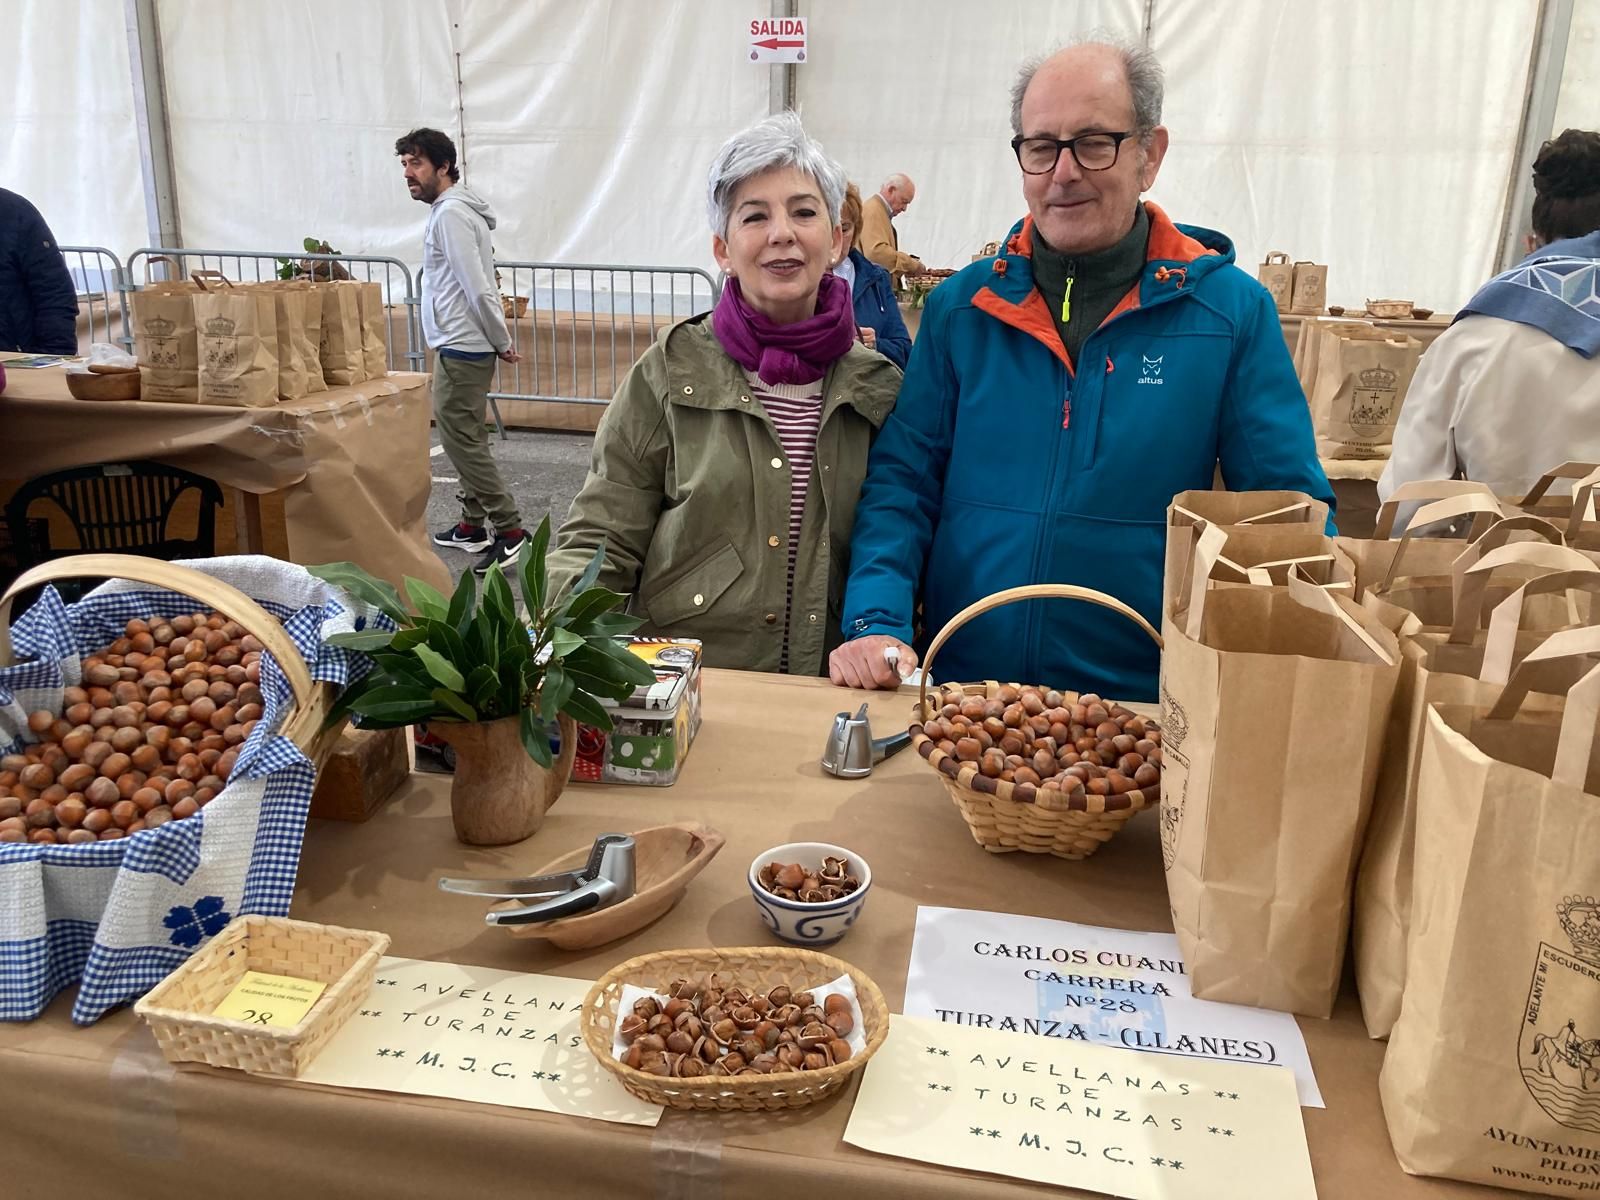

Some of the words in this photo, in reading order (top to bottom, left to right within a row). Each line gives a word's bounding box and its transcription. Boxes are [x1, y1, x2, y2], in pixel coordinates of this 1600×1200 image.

[750, 20, 804, 36] SALIDA
[1137, 376, 1164, 385] altus
[973, 941, 1089, 965] CARLOS
[1023, 969, 1175, 998] CARRERA
[1527, 974, 1546, 1026] ADELANTE
[1538, 961, 1549, 974] MI
[481, 1007, 521, 1021] DE
[1065, 993, 1137, 1014] Nº28
[401, 1011, 583, 1048] TURANZAS
[934, 1009, 1091, 1042] TURANZA
[1120, 1027, 1277, 1063] (LLANES)
[969, 1053, 1191, 1096] AVELLANAS
[1056, 1083, 1099, 1100] DE
[974, 1087, 1184, 1131] TURANZAS
